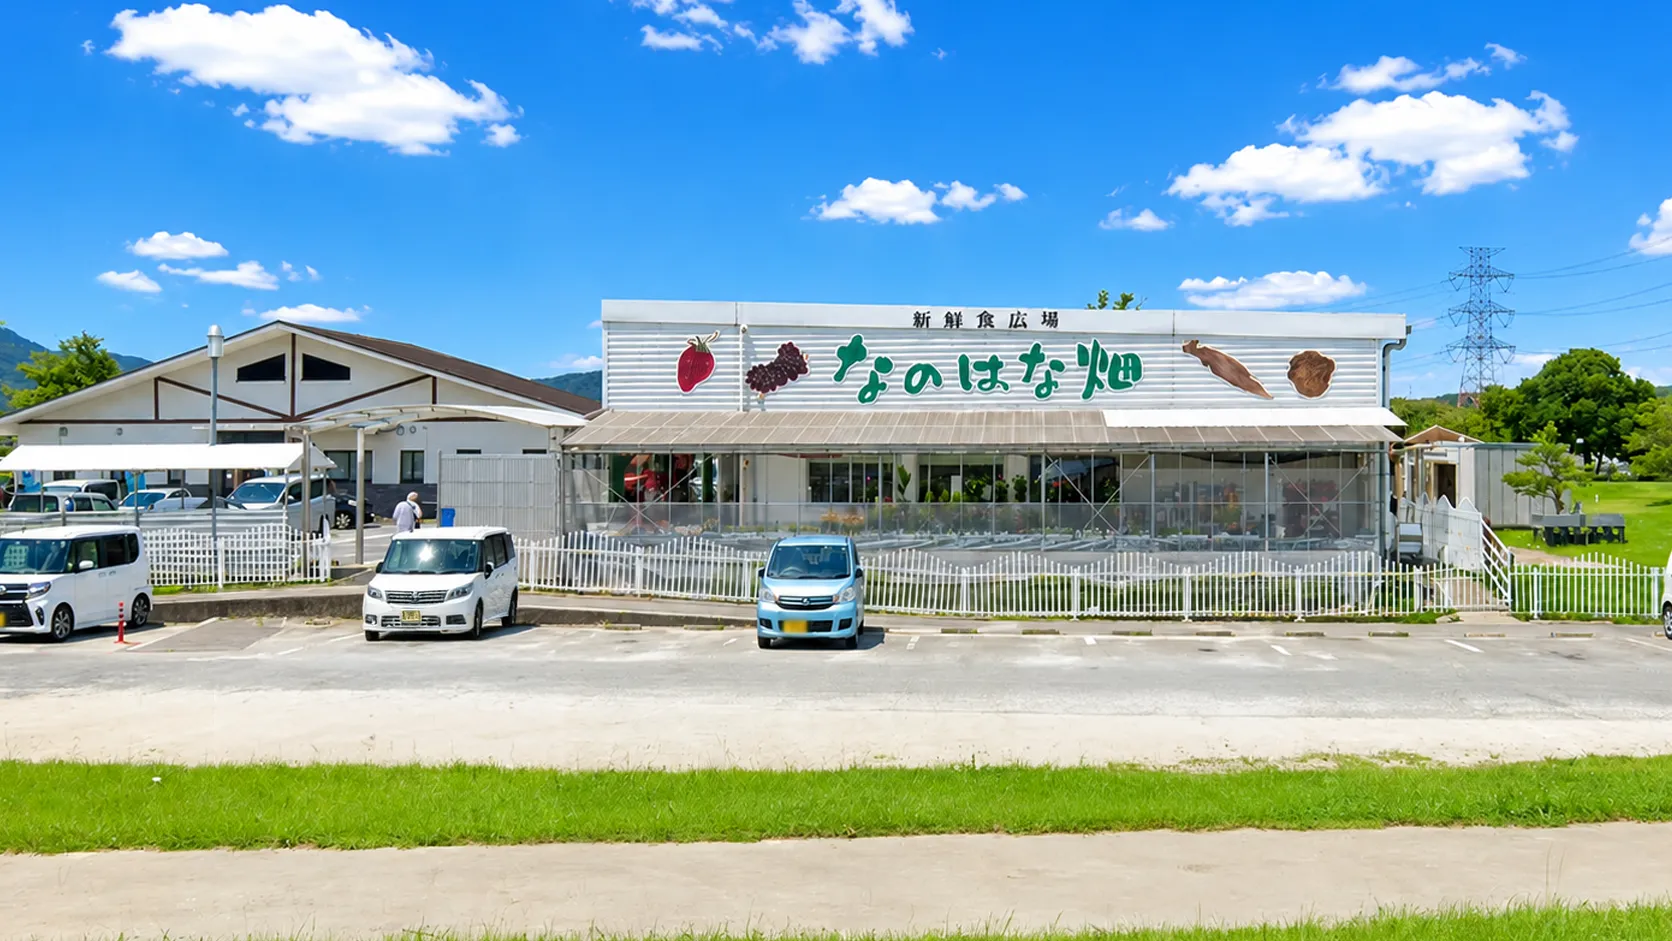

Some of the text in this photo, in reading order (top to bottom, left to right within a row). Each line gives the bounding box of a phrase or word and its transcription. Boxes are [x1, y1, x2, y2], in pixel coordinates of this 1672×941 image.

[912, 310, 1060, 329] 新鮮食広場
[834, 334, 1143, 404] なのはな畑
